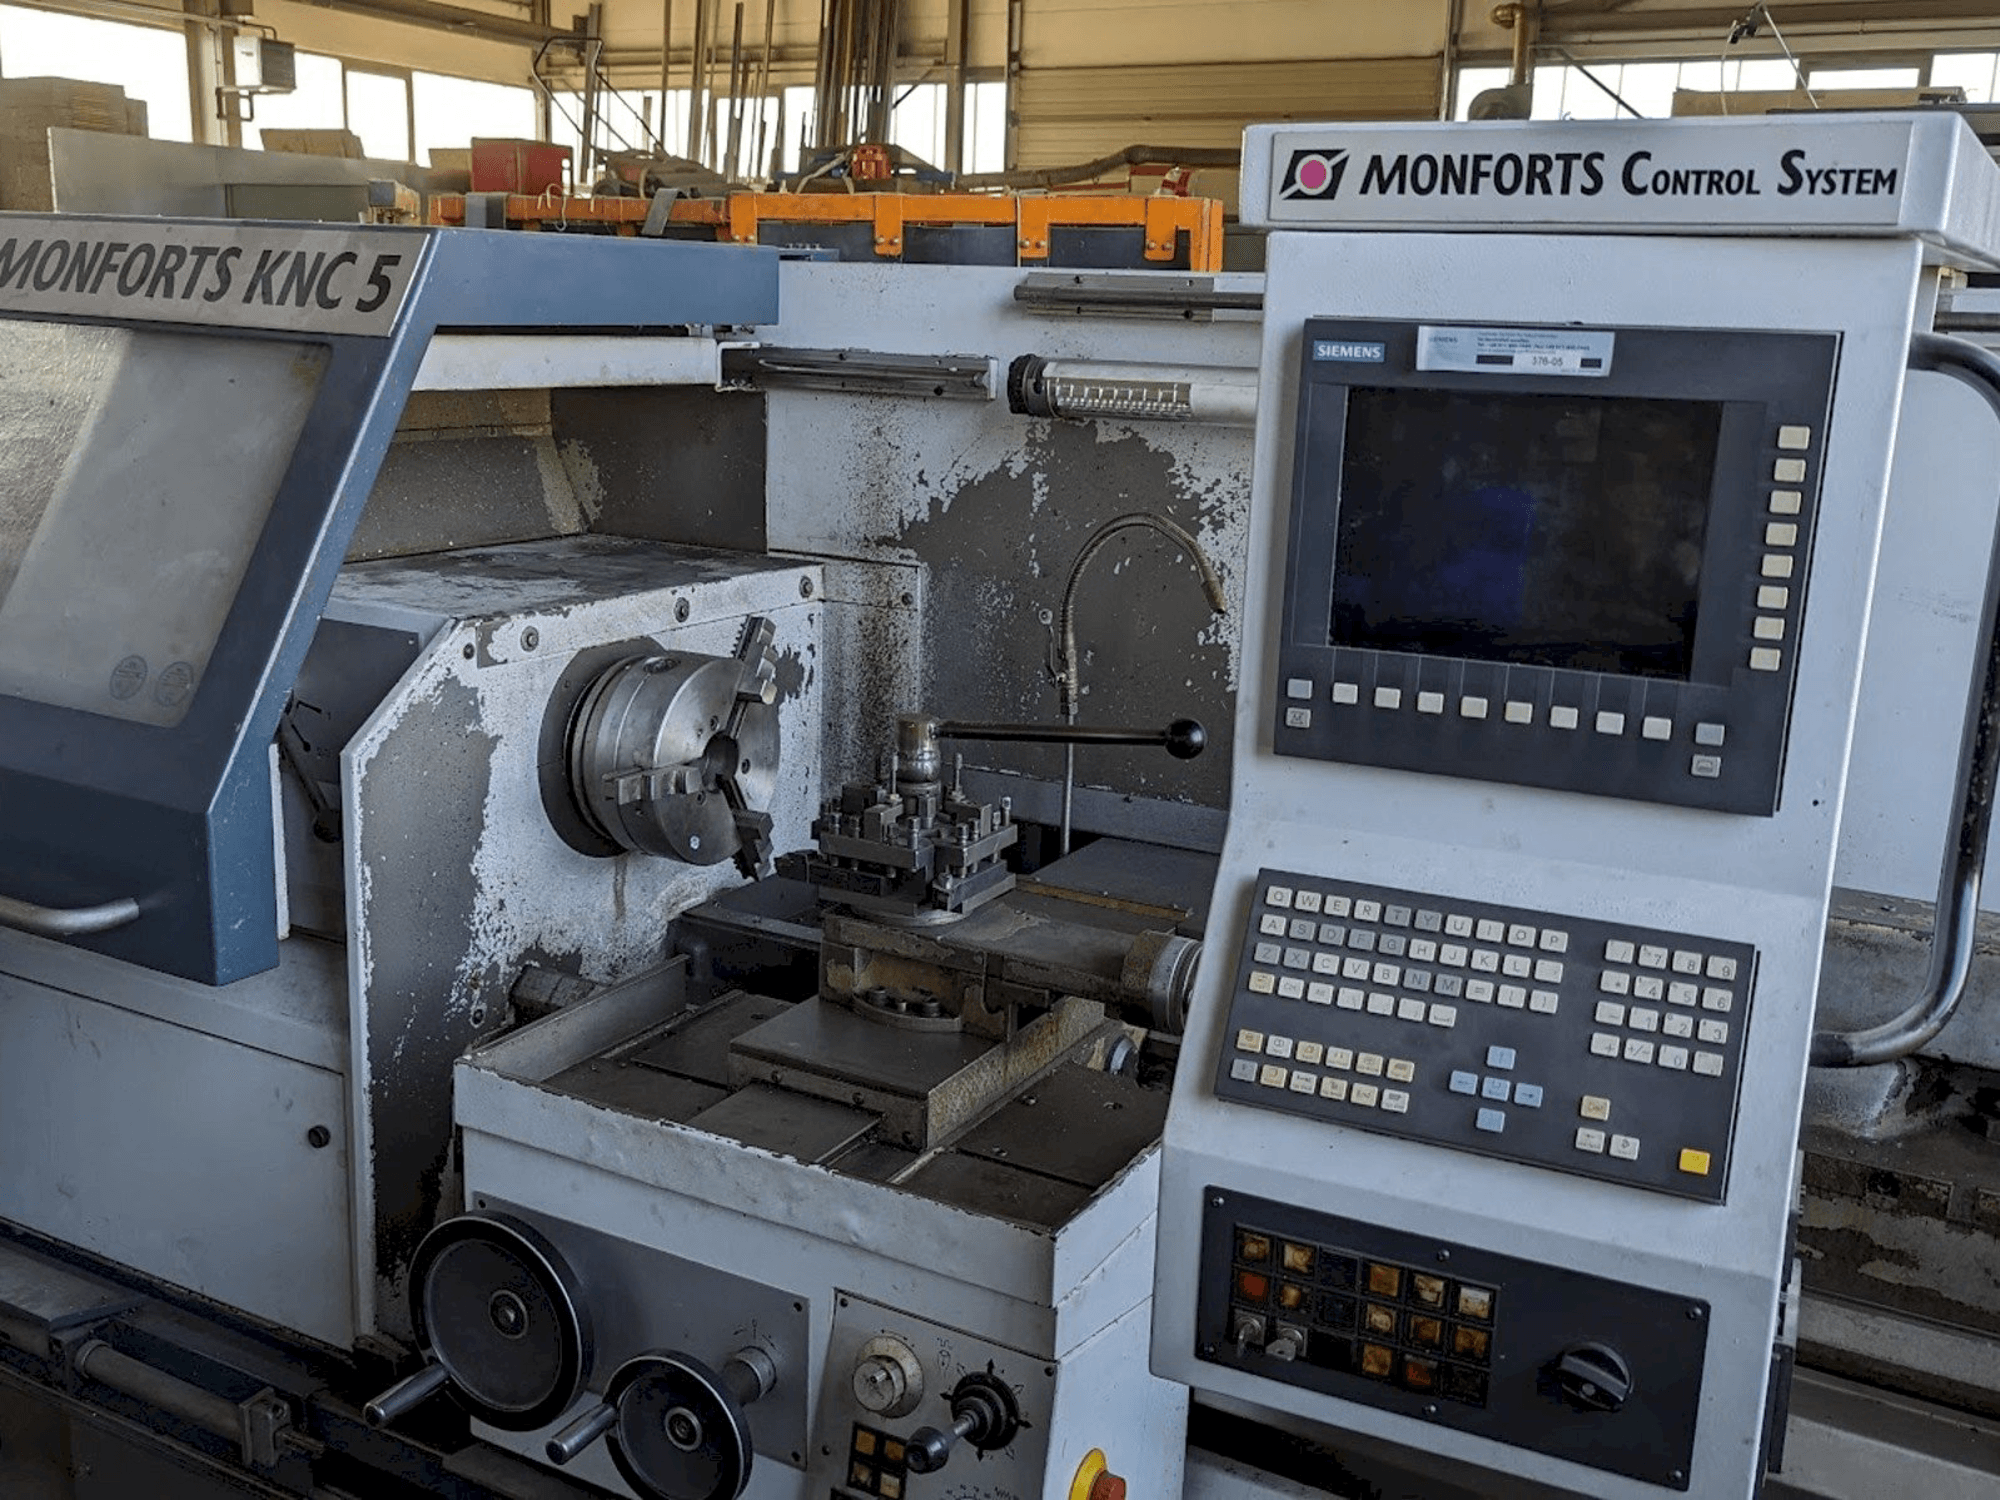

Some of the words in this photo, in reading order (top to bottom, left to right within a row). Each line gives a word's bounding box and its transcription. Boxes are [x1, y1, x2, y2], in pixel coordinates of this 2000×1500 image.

[1358, 152, 1605, 197] MONFORTS
[0, 238, 243, 303] MONFORTS
[242, 249, 358, 310] KNC
[355, 254, 402, 313] 5
[1317, 344, 1381, 359] SIEMENS
